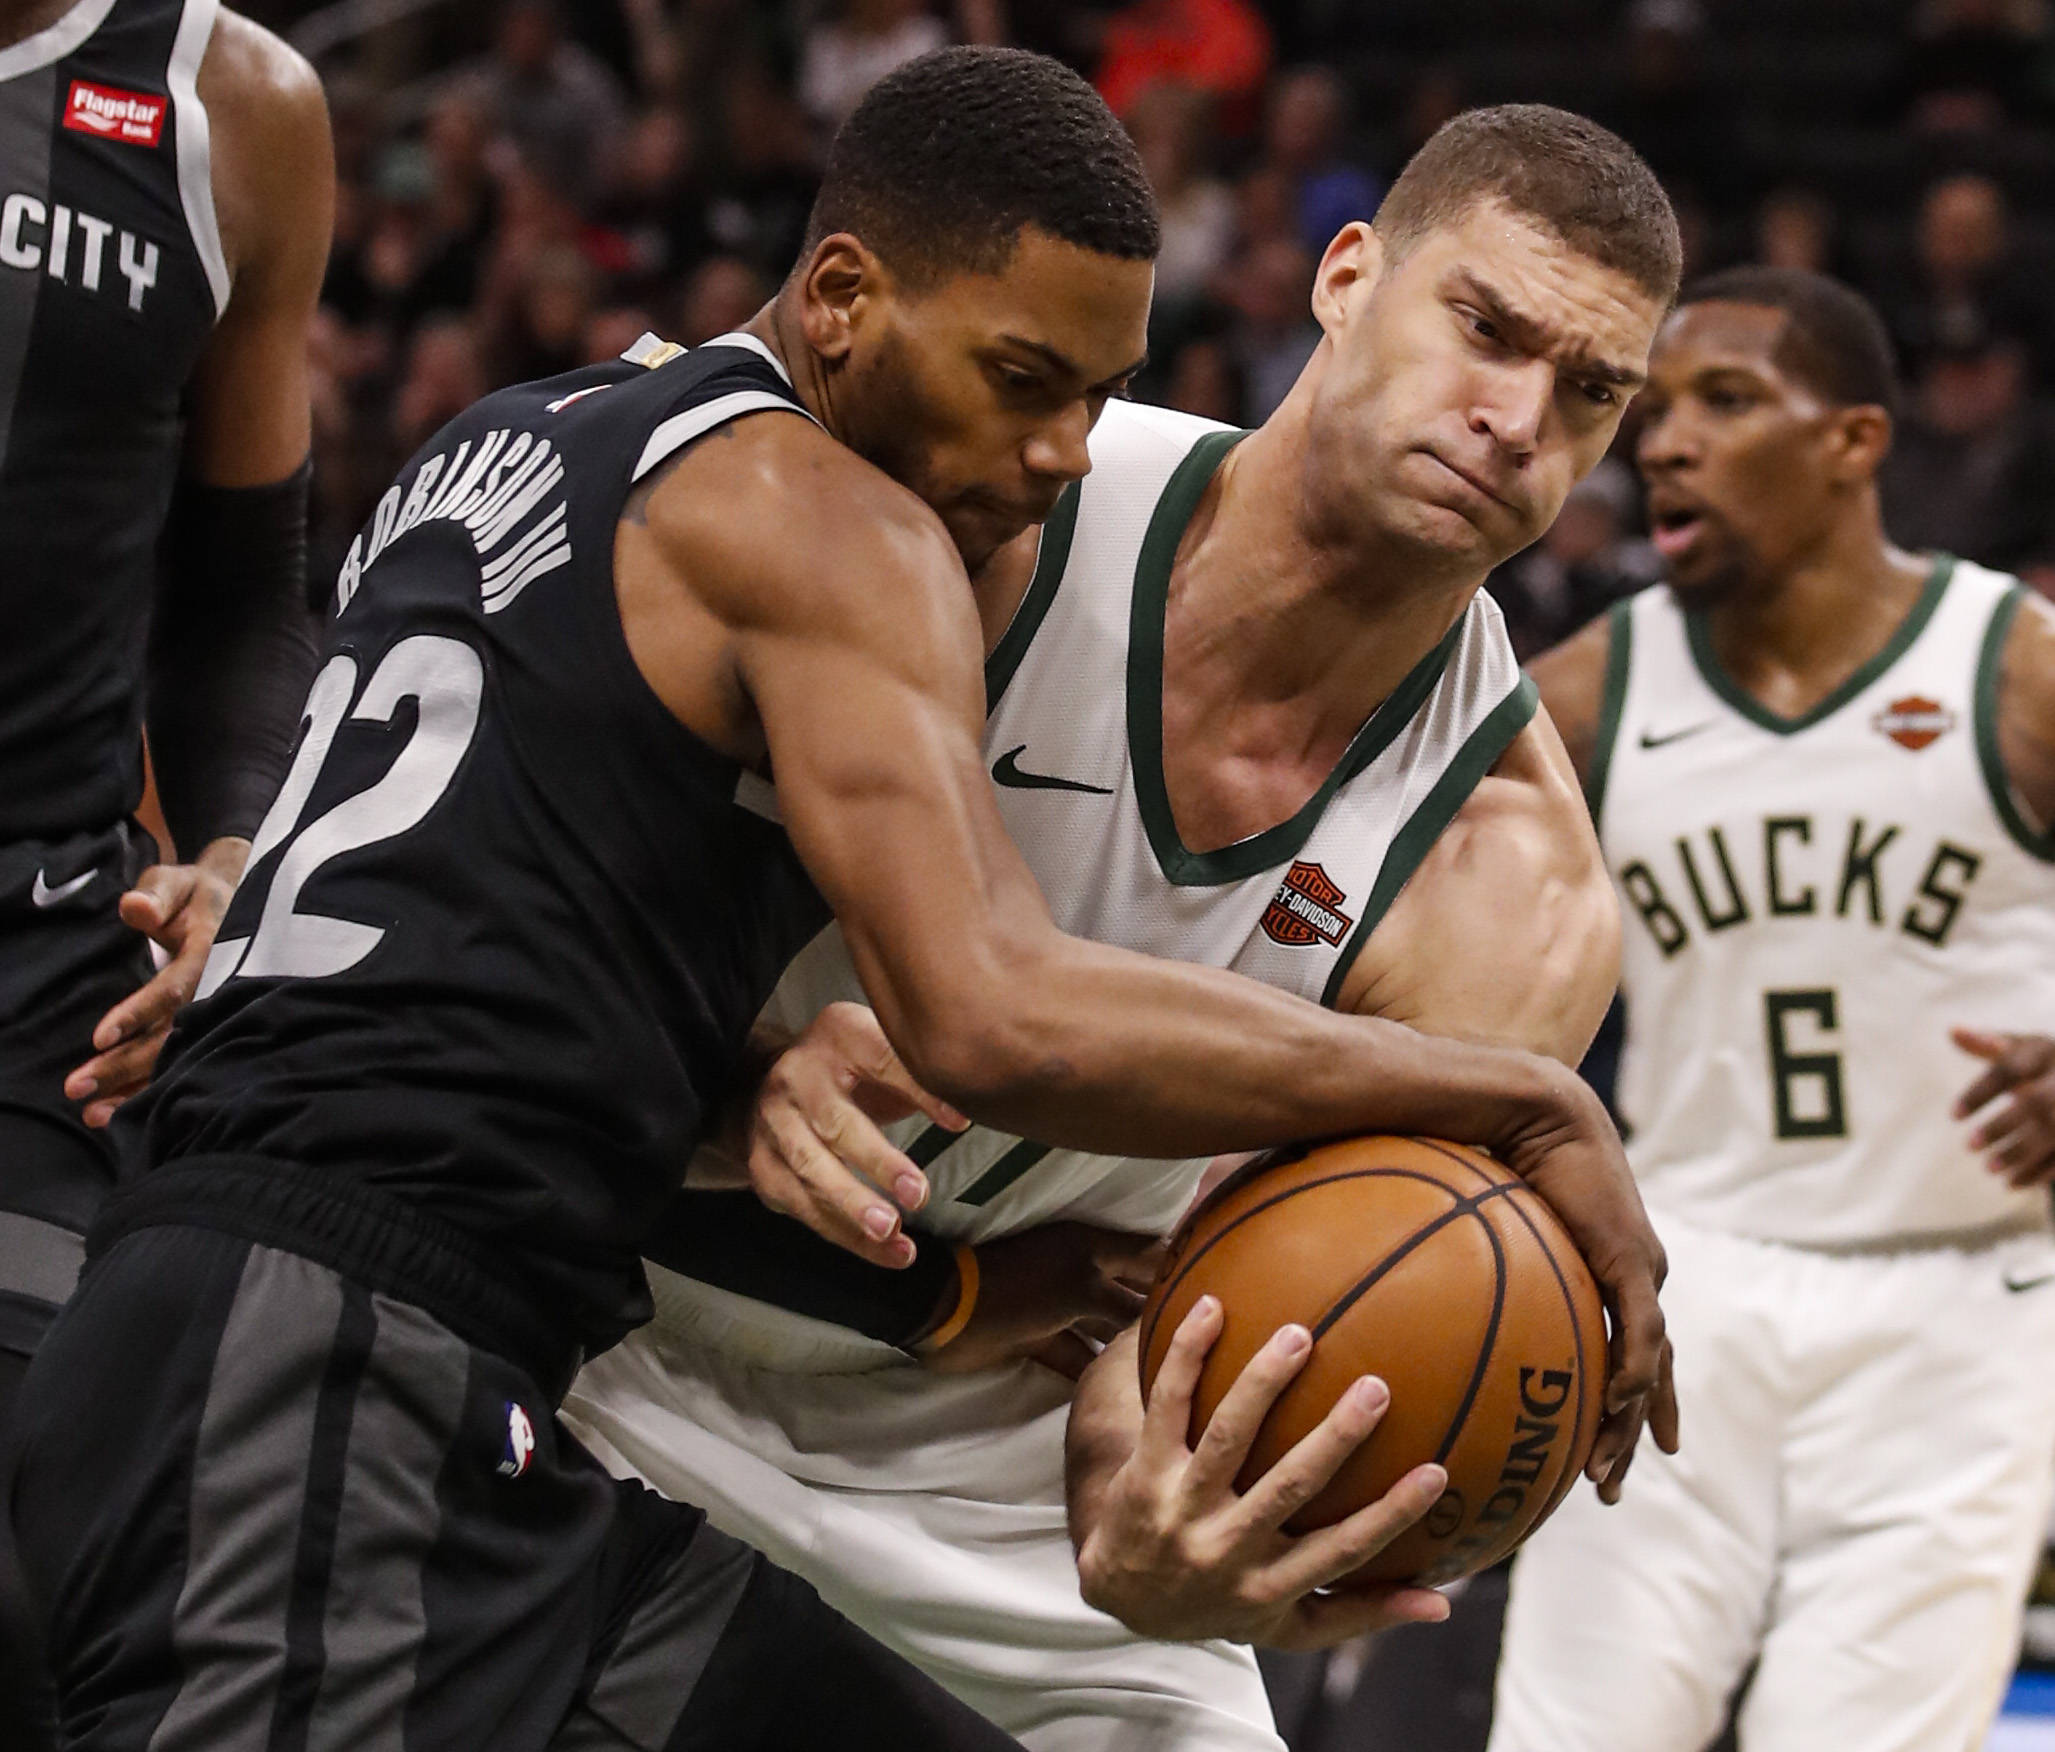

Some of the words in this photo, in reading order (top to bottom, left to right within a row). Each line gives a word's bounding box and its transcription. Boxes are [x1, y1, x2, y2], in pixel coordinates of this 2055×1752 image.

[73, 87, 159, 123] Flagstar
[0, 193, 160, 313] CITY
[336, 428, 565, 619] ROBINSON
[480, 500, 572, 614] III
[192, 635, 485, 1002] 22
[1266, 906, 1310, 939] YCLES
[1275, 885, 1344, 938] Y-DAVIDSON
[1619, 815, 1984, 961] BUCKS
[1764, 986, 1849, 1140] 6
